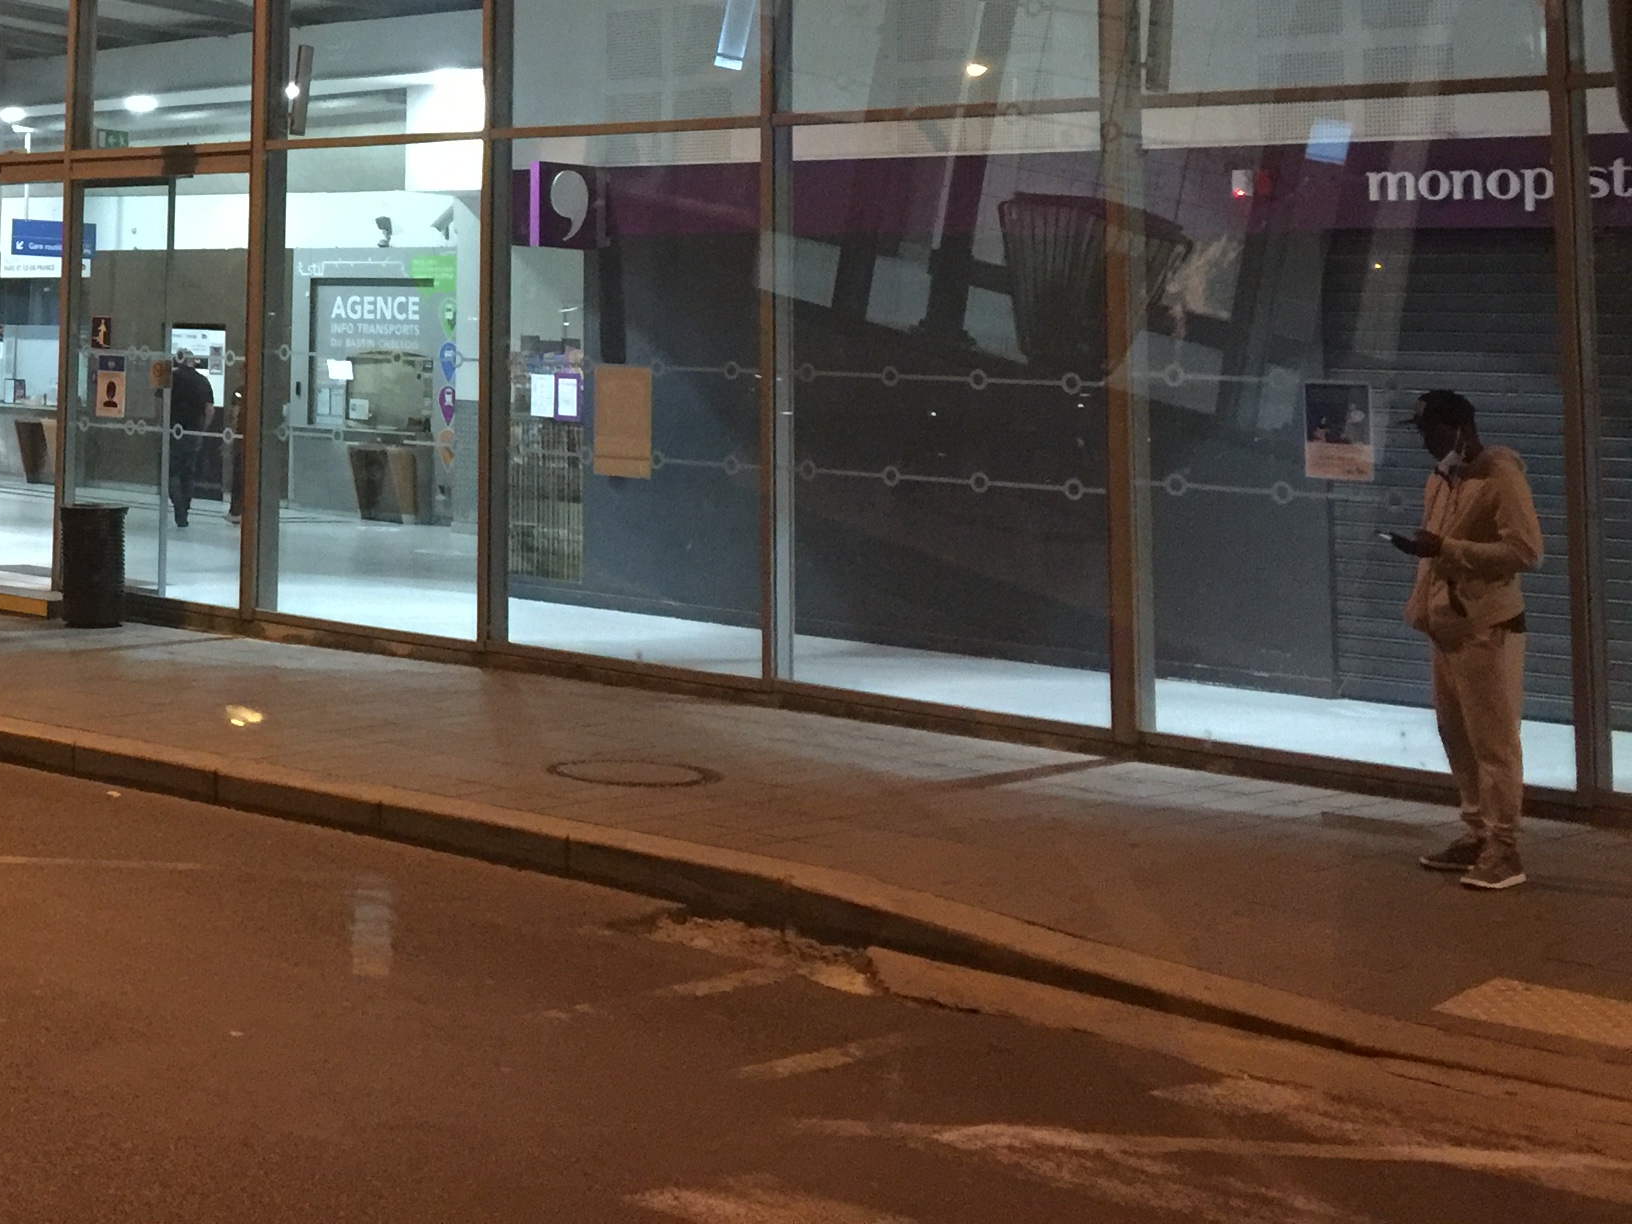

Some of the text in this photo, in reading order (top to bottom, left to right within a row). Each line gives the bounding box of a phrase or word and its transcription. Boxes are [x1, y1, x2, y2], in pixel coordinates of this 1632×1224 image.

[1365, 157, 1632, 212] monopst
[28, 242, 44, 250] Gare
[330, 295, 420, 321] AGENCE
[330, 322, 419, 336] INFO TRANSPORTS
